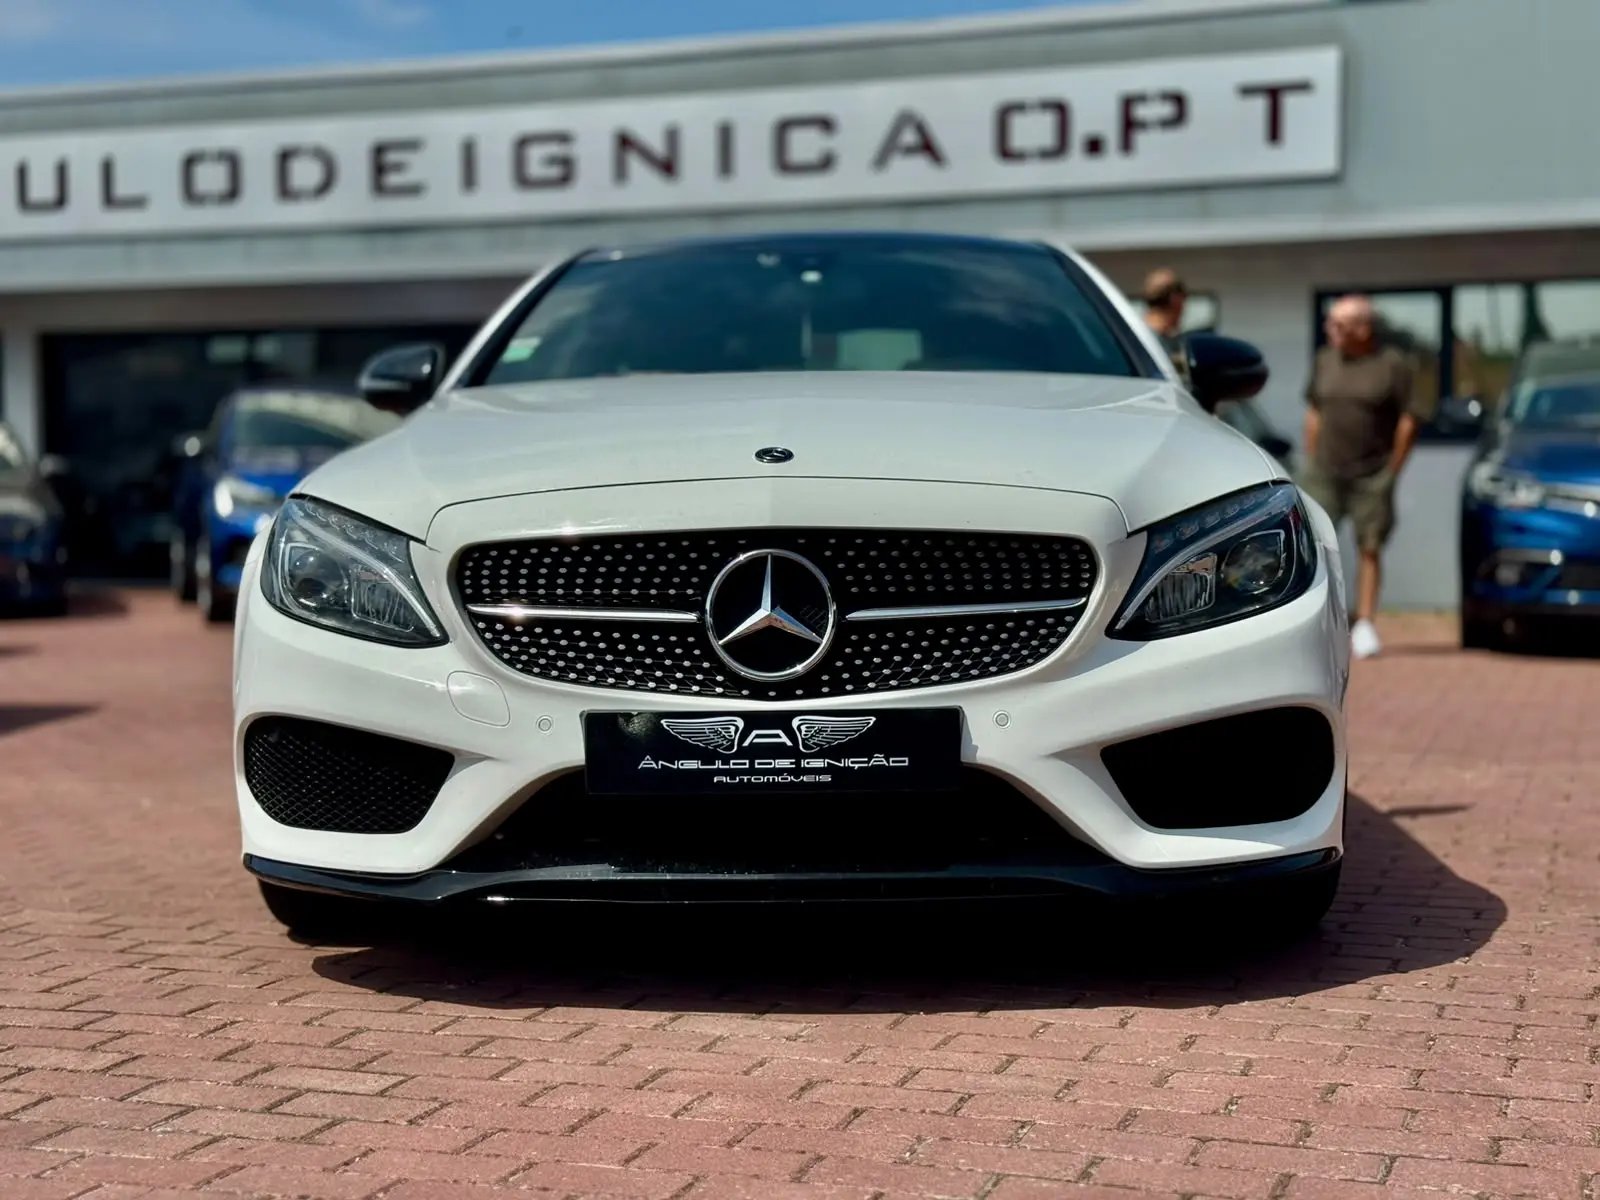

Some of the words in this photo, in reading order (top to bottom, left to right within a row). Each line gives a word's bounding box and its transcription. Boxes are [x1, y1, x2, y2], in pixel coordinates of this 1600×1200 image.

[638, 755, 749, 769] ÂNGULO
[754, 759, 796, 769] DE
[801, 753, 909, 770] IGNIÇÃO
[713, 772, 832, 783] AUTOMÓVEIS
